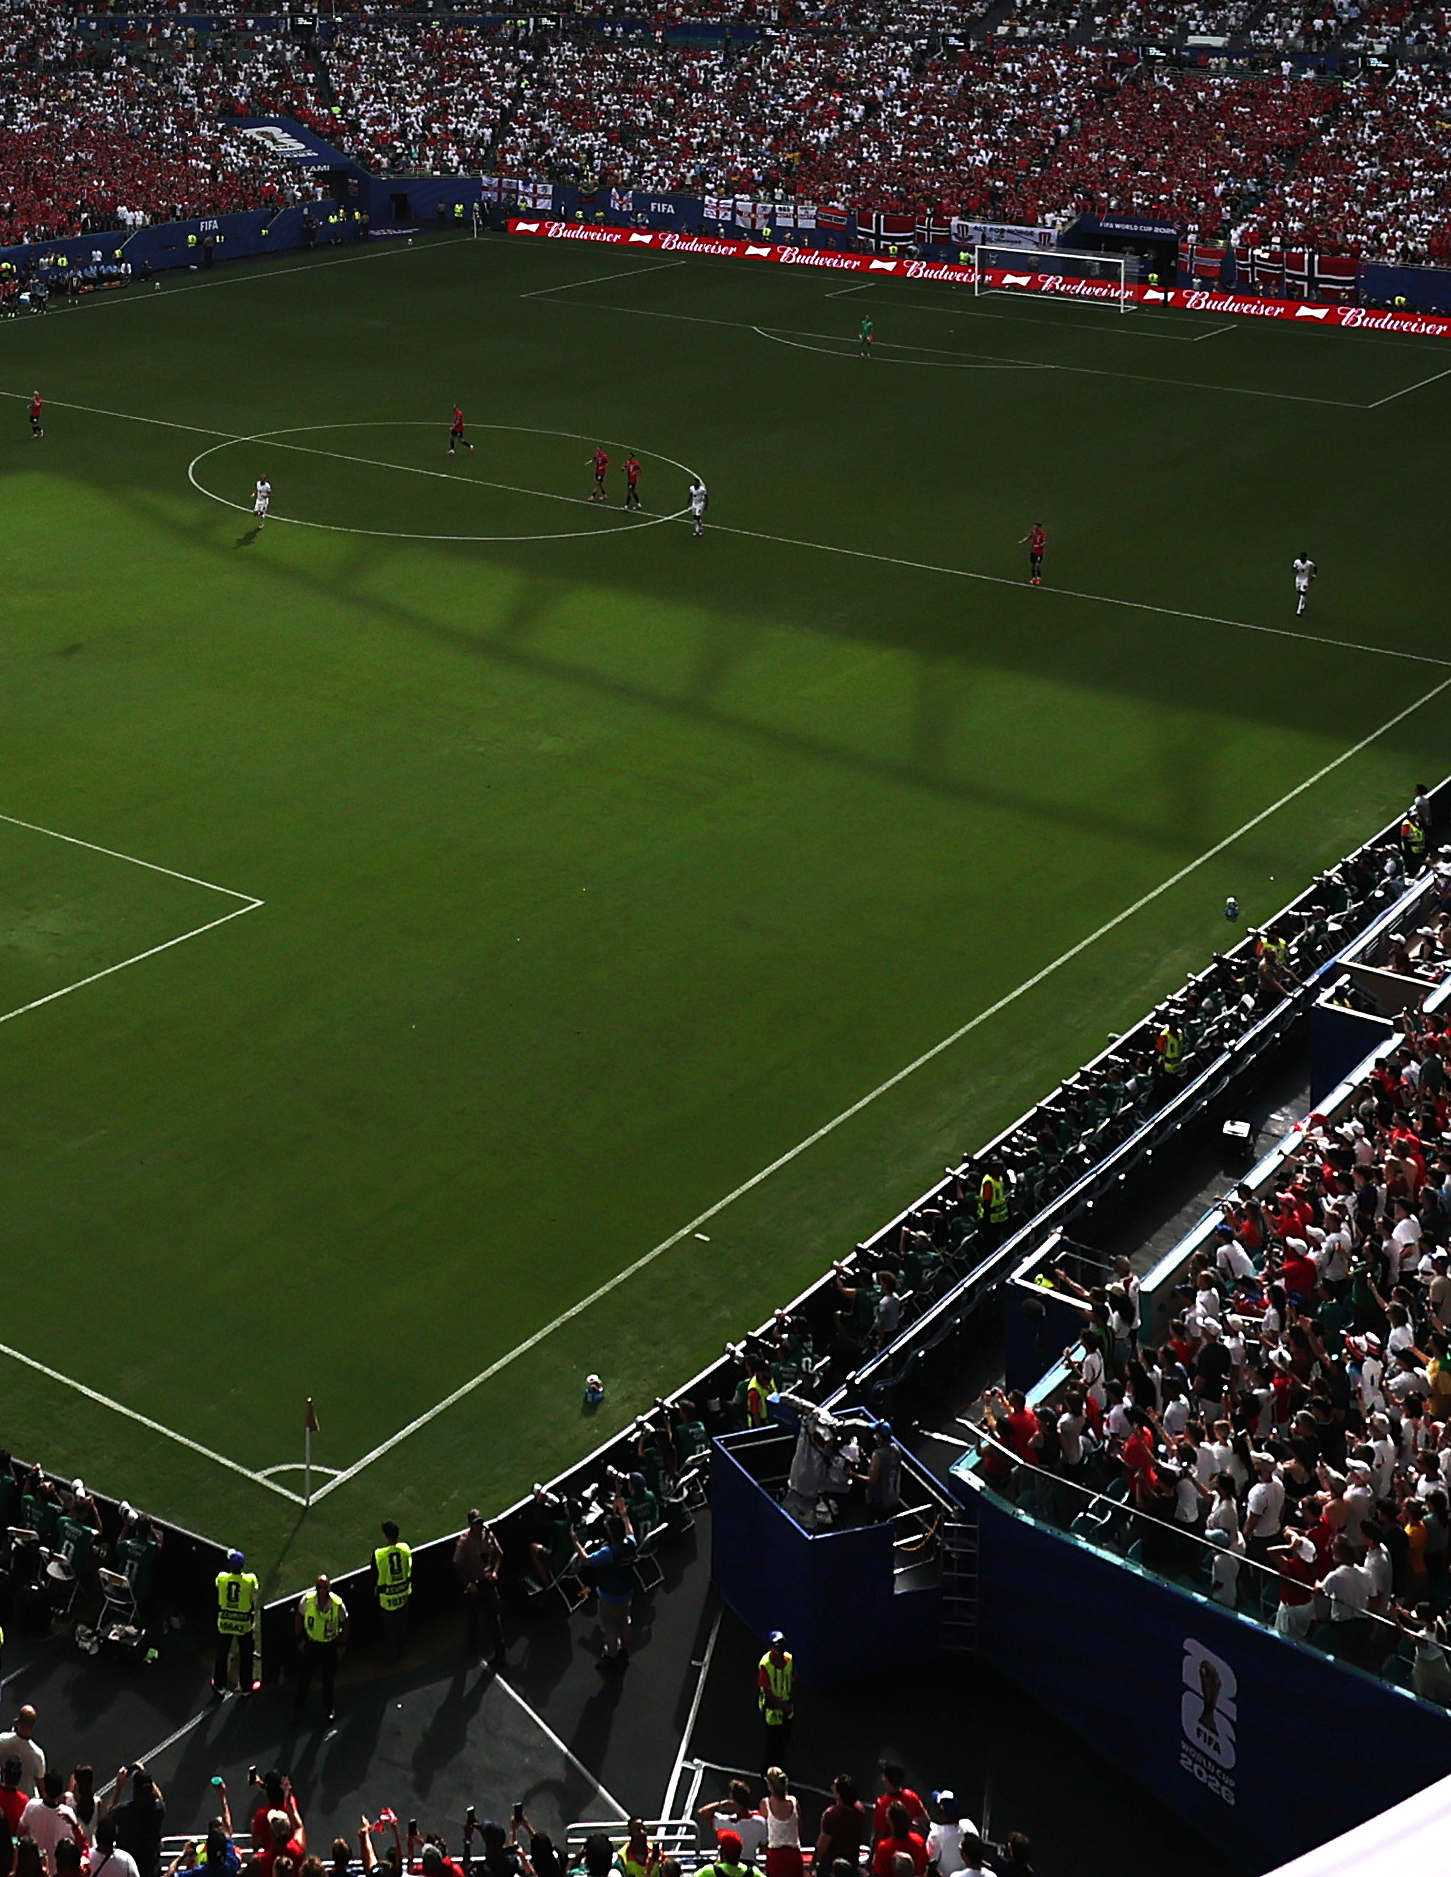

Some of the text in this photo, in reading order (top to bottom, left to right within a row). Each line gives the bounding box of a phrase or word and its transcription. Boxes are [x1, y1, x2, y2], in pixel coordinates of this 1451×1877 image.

[651, 203, 674, 214] FIFA
[201, 220, 218, 231] FIFA
[545, 222, 621, 242] Budweiser
[659, 233, 736, 255] Budweiser
[777, 242, 860, 269] Budweiser
[1183, 289, 1284, 316] Budweiser
[1338, 307, 1447, 334] Budweiser
[1196, 1726, 1222, 1757] FIFA
[1179, 1741, 1236, 1789] WORLD CUP
[1179, 1754, 1236, 1807] 2026
